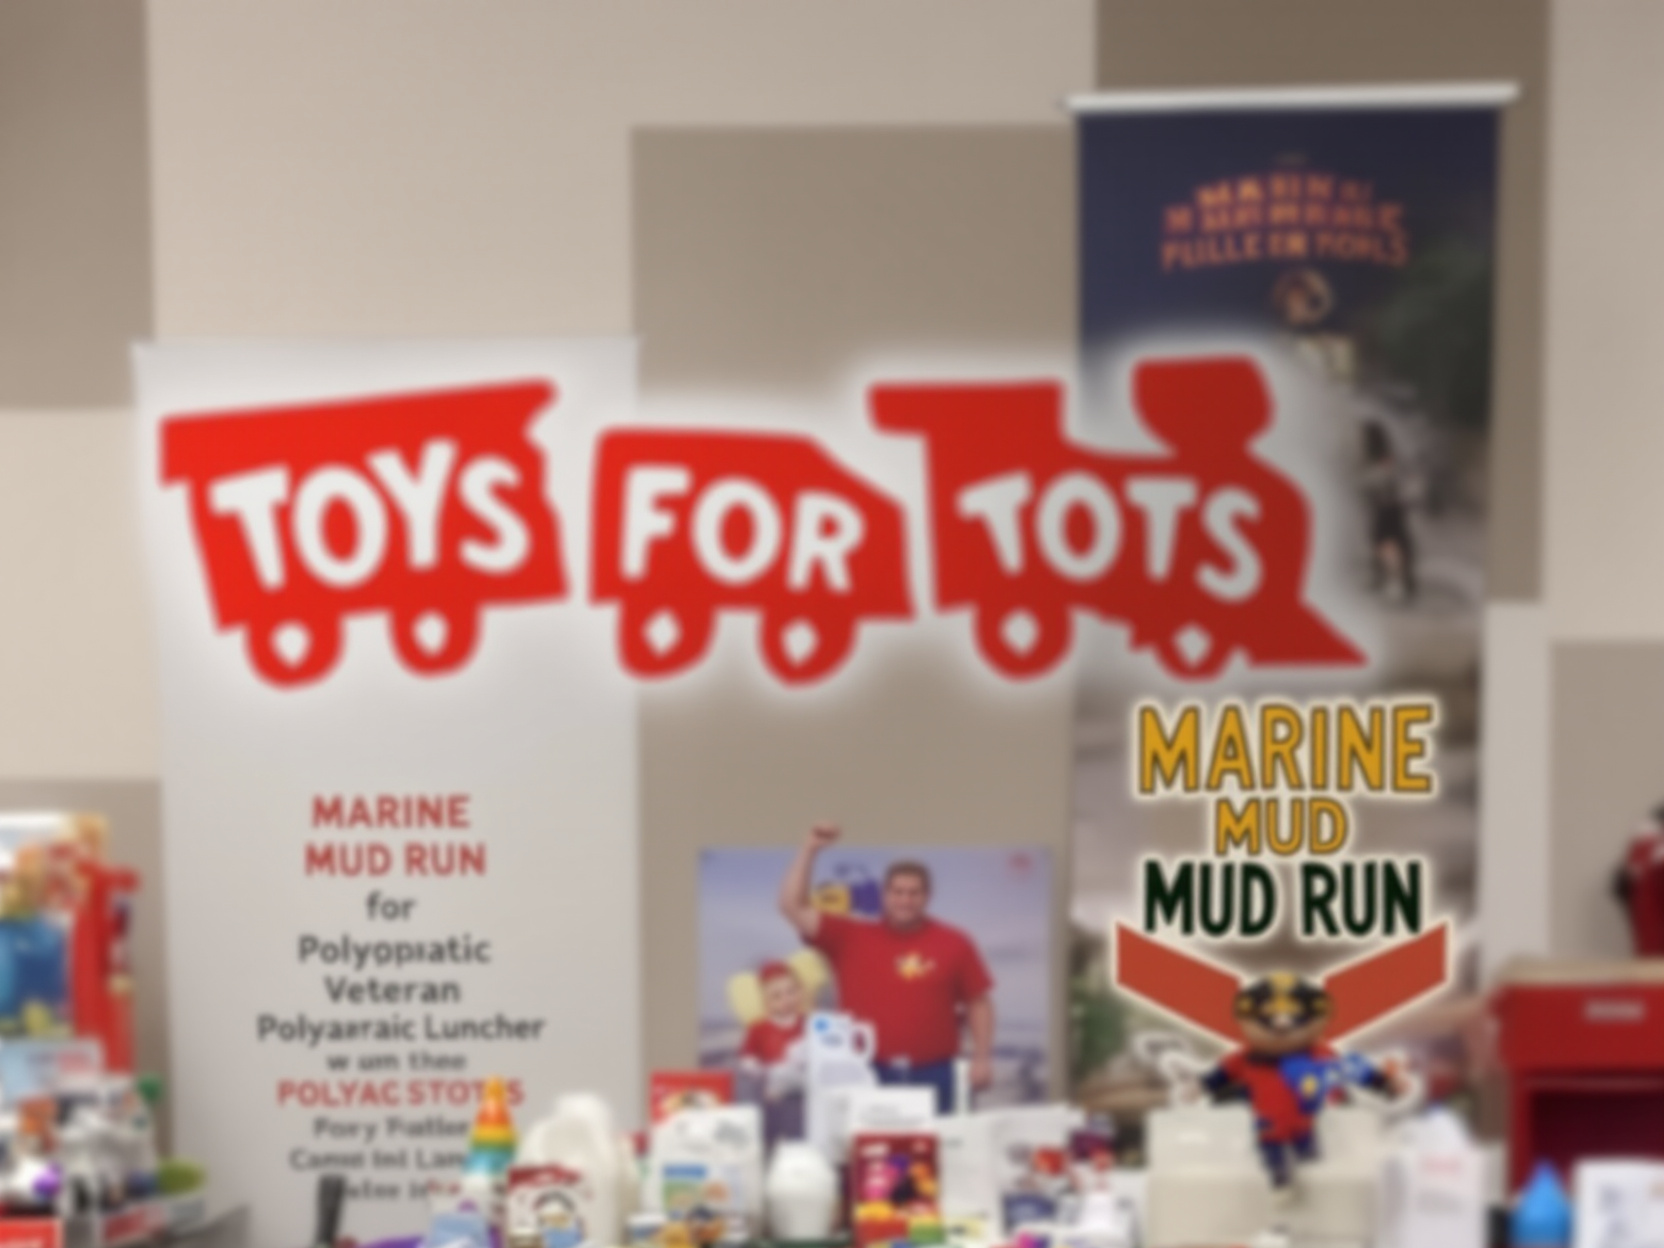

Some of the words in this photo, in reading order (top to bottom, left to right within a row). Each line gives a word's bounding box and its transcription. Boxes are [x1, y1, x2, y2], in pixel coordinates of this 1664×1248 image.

[207, 438, 531, 592] TOYS
[621, 465, 865, 593] FOR
[955, 468, 1264, 603] TOTS
[1138, 703, 1435, 795] MARINE
[311, 795, 471, 828] MARINE
[1214, 796, 1349, 857] MUD
[304, 843, 393, 876] MUD
[404, 843, 487, 876] RUN
[366, 890, 415, 921] for
[1144, 858, 1278, 937] MUD
[1300, 860, 1422, 937] RUN
[324, 976, 461, 1004] Veteran
[424, 1014, 545, 1041] Luncher
[276, 1080, 400, 1108] POLYAC
